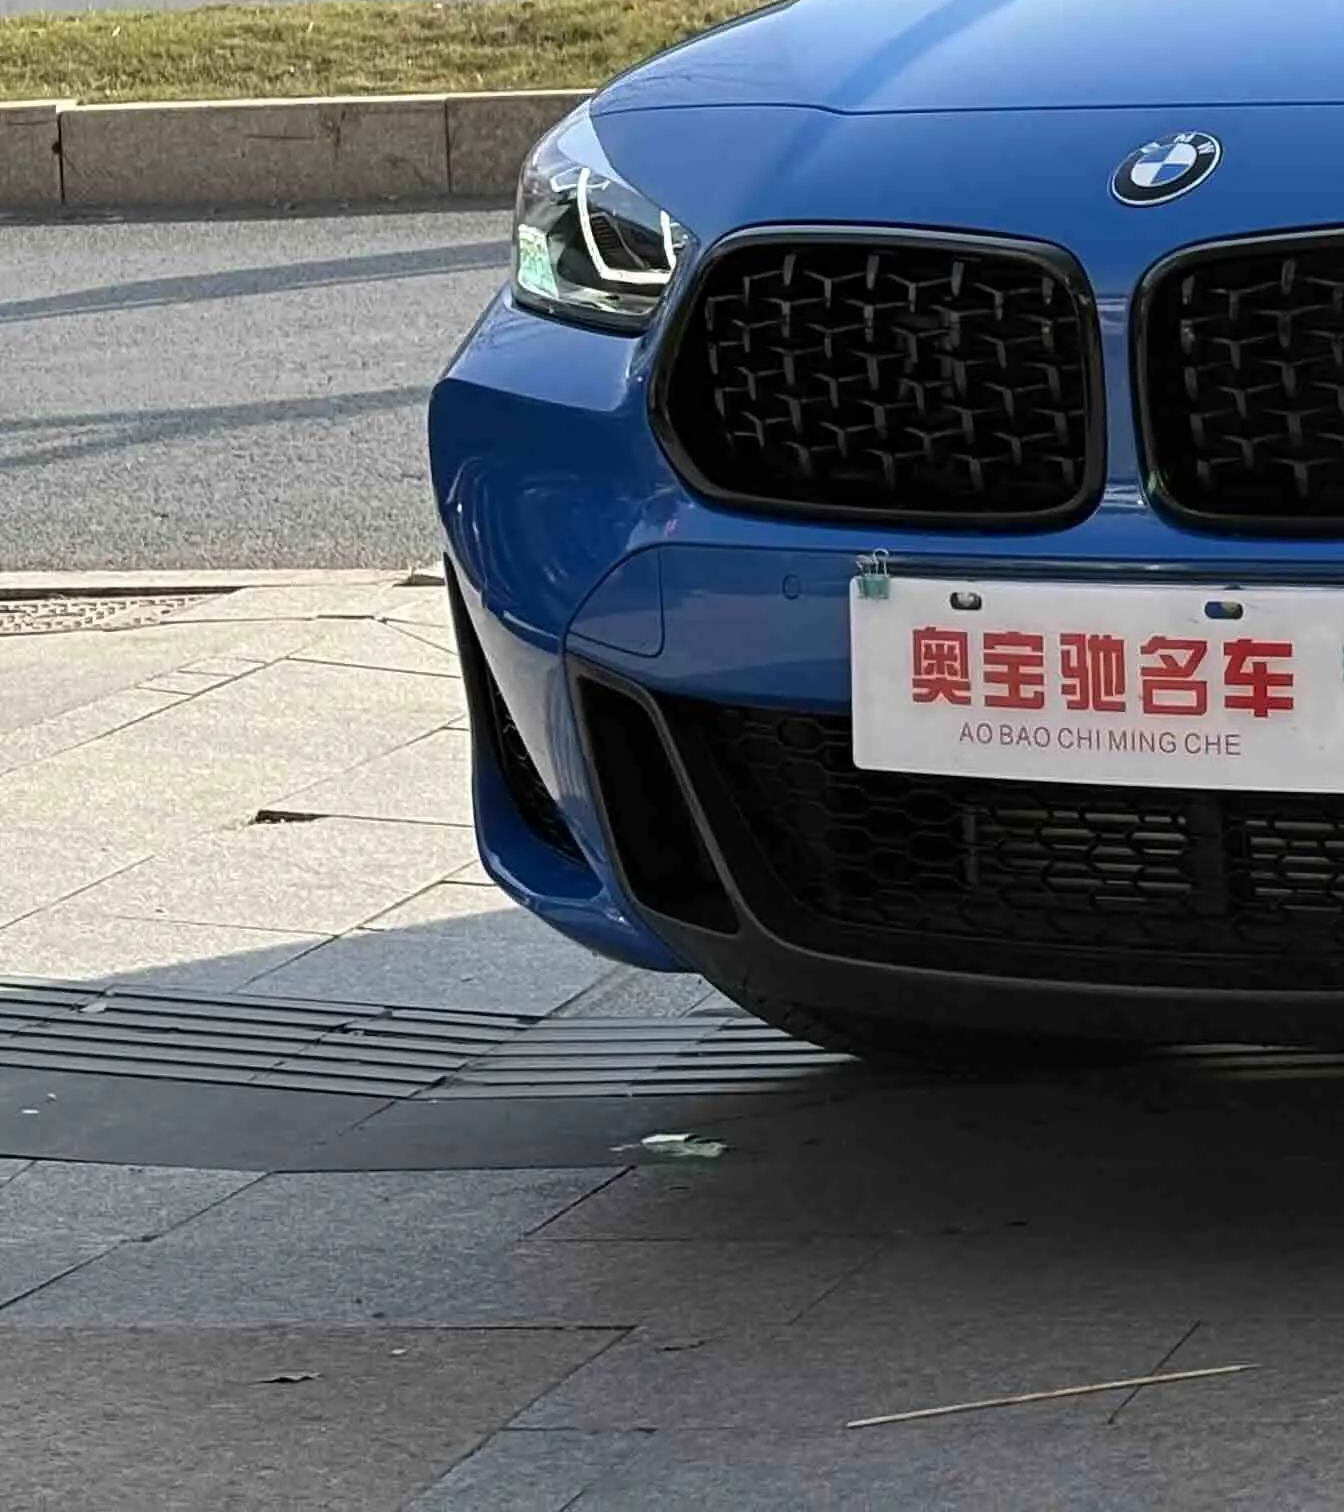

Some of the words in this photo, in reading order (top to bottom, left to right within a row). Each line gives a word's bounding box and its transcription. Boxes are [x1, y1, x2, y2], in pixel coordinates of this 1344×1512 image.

[912, 626, 1294, 718] 奥宝驰名车
[959, 722, 993, 744] AO
[999, 724, 1050, 748] BAO
[1057, 727, 1100, 751] CHI
[1107, 729, 1177, 754] MING
[1184, 732, 1241, 755] CHE
